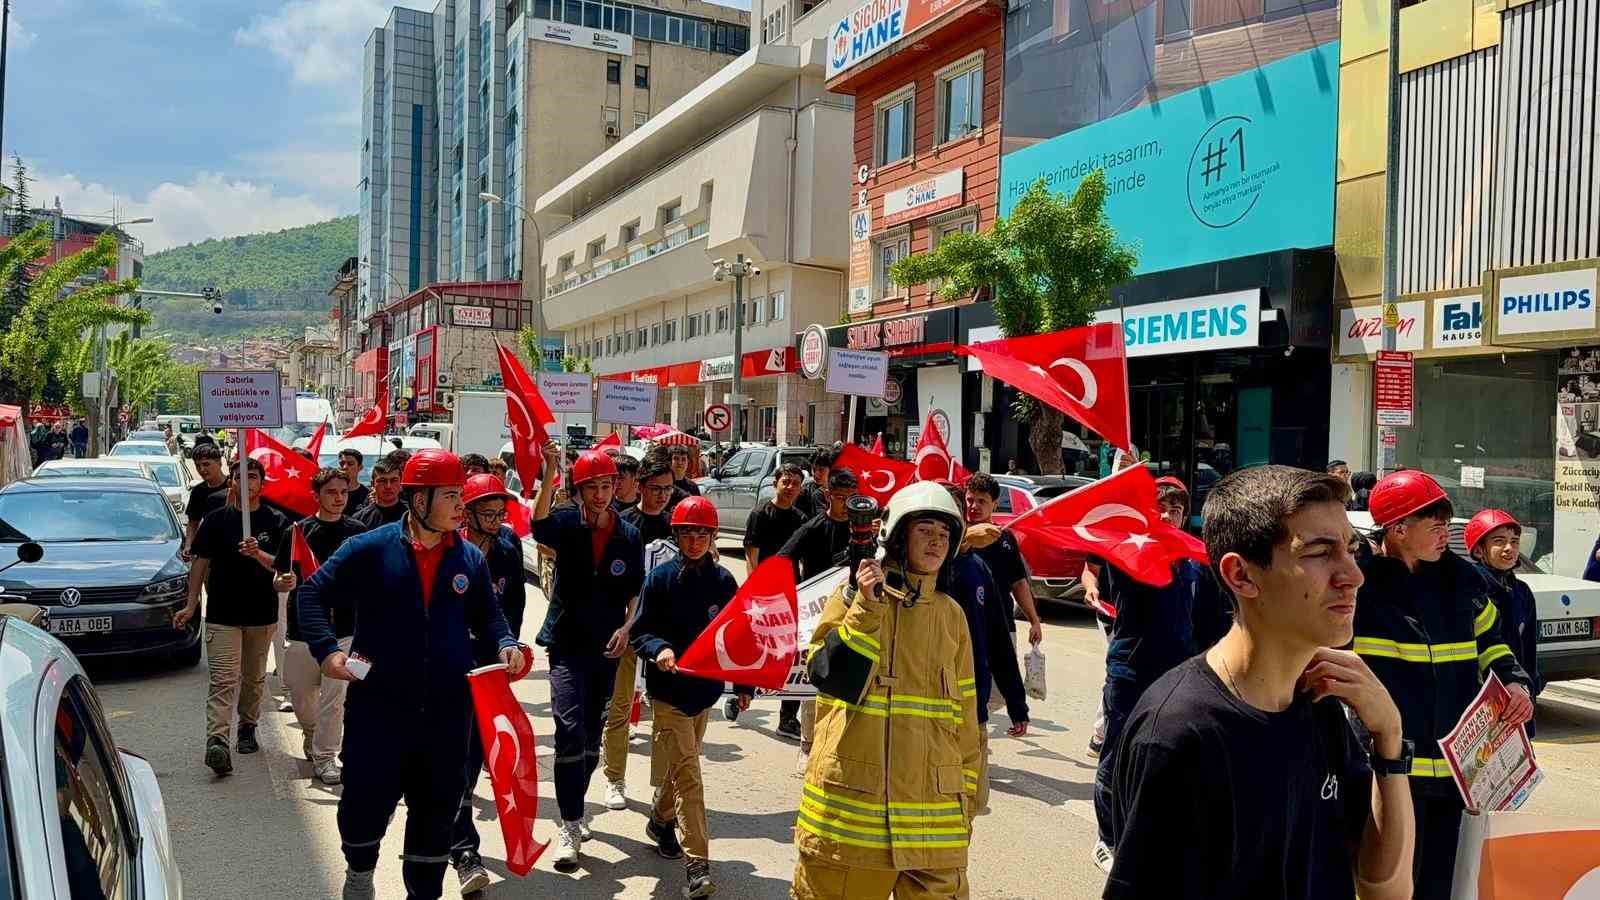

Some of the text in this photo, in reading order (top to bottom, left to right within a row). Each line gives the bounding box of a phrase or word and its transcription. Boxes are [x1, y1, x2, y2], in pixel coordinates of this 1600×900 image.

[852, 10, 902, 60] HANE
[1102, 139, 1162, 170] tasarım,
[1201, 127, 1245, 187] #1
[915, 188, 937, 205] HANE
[1503, 288, 1591, 315] PHILIPS
[1125, 303, 1247, 347] SIEMENS
[1348, 316, 1416, 339] arzm
[1442, 331, 1482, 341] HAUSG
[224, 375, 255, 384] Sabırla
[210, 387, 270, 397] dürüstlükle ve
[223, 400, 258, 409] ustalıkla
[217, 412, 265, 422] yetişiyoruz
[1555, 482, 1583, 492] Tekstil
[1556, 494, 1570, 507] Üst
[59, 619, 81, 632] ARA
[88, 618, 111, 630] 085
[1543, 623, 1553, 636] 10
